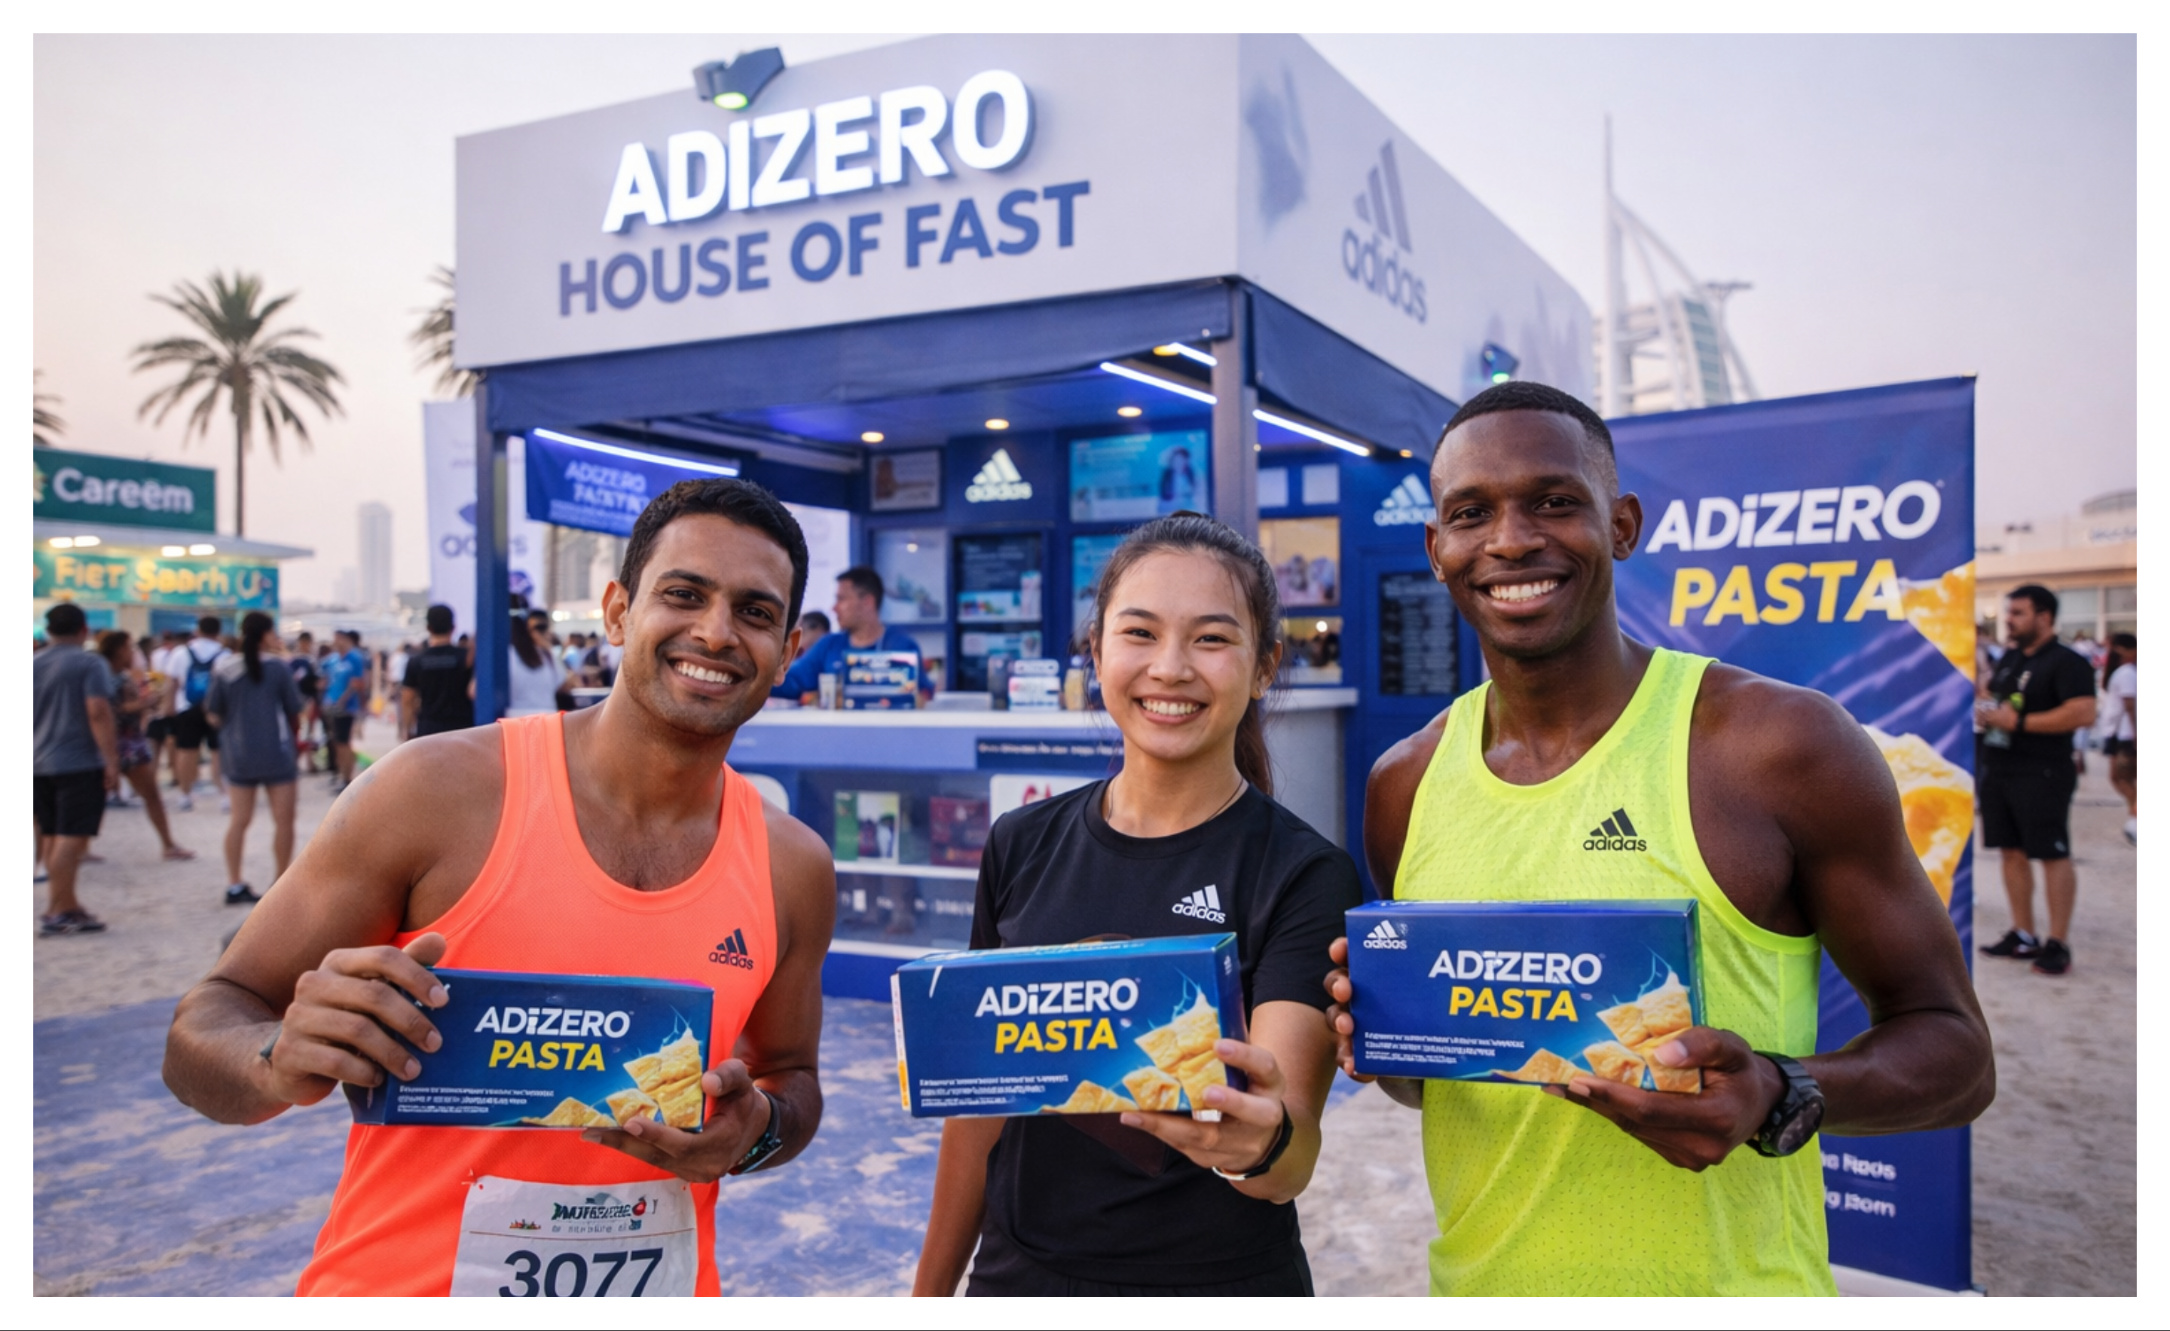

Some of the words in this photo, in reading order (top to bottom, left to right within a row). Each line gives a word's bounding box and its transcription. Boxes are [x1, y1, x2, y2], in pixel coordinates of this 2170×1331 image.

[601, 69, 1033, 233] ADIZERO
[558, 231, 770, 318] HOUSE
[789, 211, 883, 282] OF
[905, 181, 1092, 269] FAST
[1341, 228, 1427, 325] adidas
[1669, 559, 1906, 627] PASTA
[1583, 834, 1647, 852] adidas
[1172, 903, 1226, 924] adidas
[709, 951, 754, 970] adidas
[1449, 986, 1579, 1022] PASTA
[995, 1017, 1118, 1054] PASTA
[488, 1039, 606, 1071] PASTA
[499, 1247, 664, 1297] 3077
